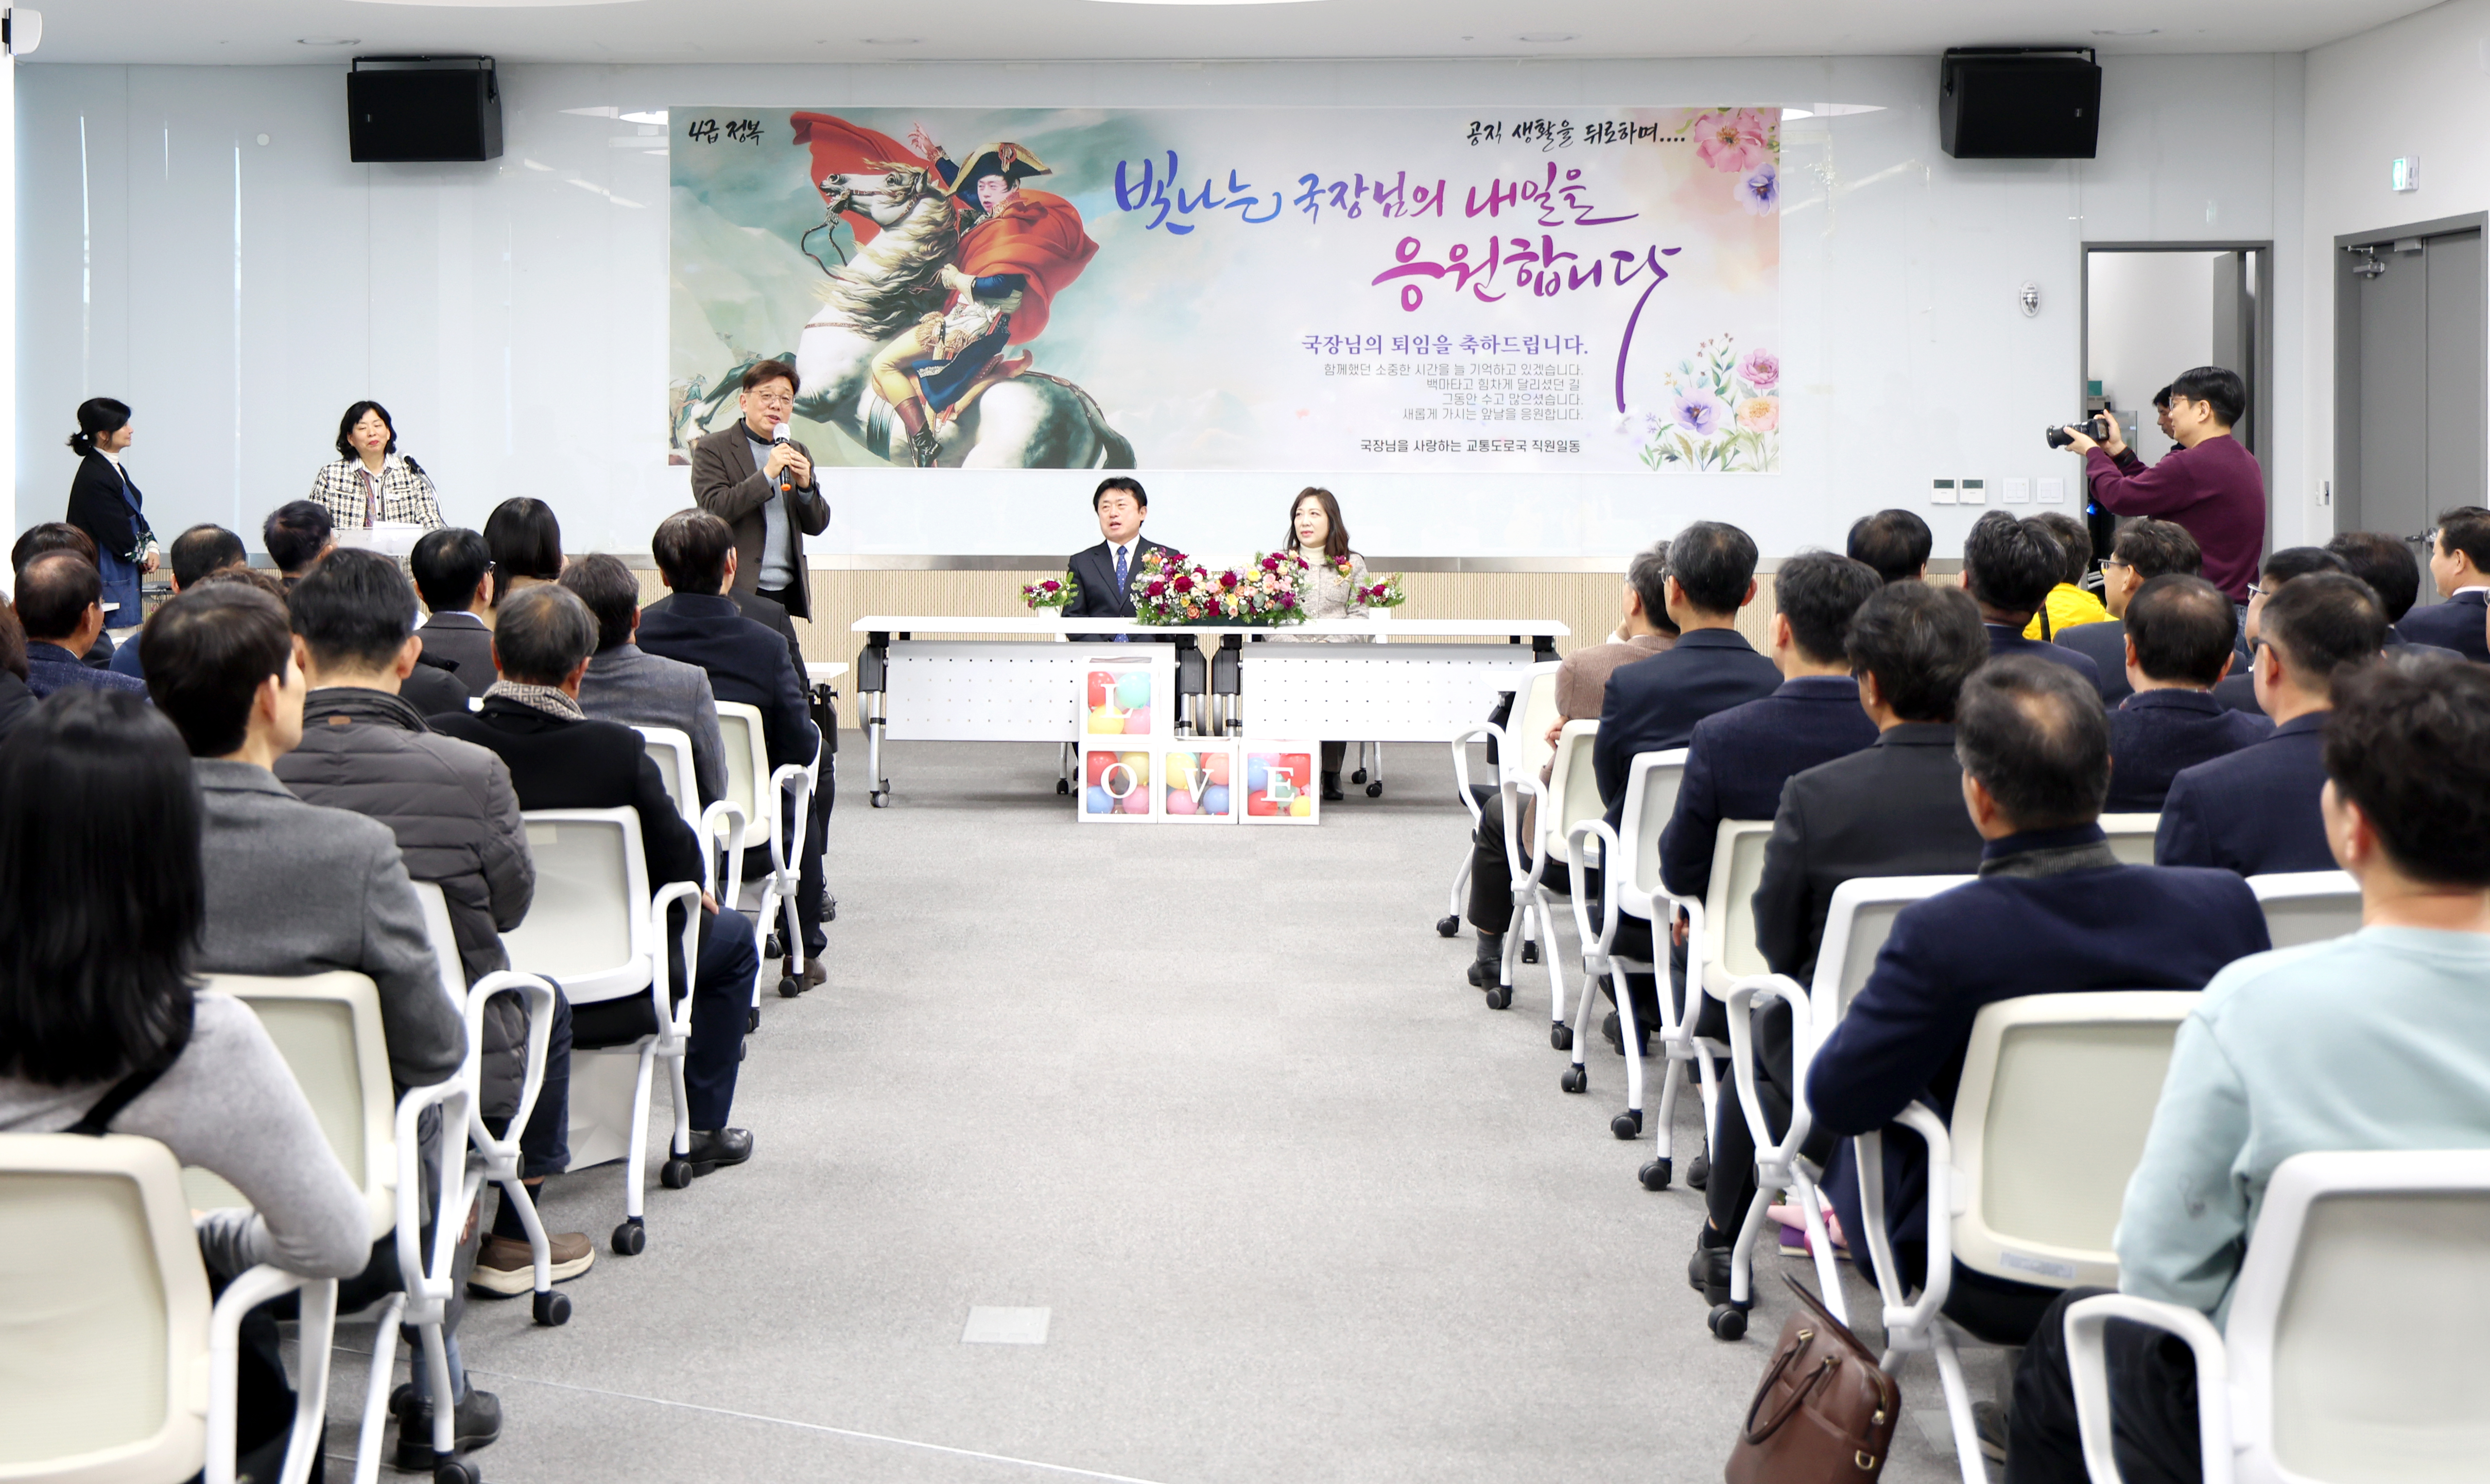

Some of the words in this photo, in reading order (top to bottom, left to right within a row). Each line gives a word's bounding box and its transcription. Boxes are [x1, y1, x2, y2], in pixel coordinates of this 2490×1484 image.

[688, 119, 720, 144] 4급
[1466, 121, 1502, 146] 공직
[1511, 118, 1574, 152] 생활을
[1114, 150, 1282, 235] 빛나는
[1293, 171, 1446, 224] 국장님의
[1465, 161, 1639, 227] 내일을
[1371, 234, 1682, 414] 응원합니다
[1302, 334, 1382, 355] 국장님의
[1391, 334, 1452, 355] 퇴임을
[1459, 334, 1588, 355] 축하드립니다.
[1325, 363, 1370, 376] 함께했던
[1376, 363, 1411, 376] 소중한
[1415, 363, 1449, 376] 시간을
[1454, 363, 1465, 376] 늘
[1470, 363, 1516, 376] 기억하고
[1521, 363, 1583, 376] 있겠습니다.
[1427, 378, 1473, 390] 백마타고
[1478, 378, 1512, 391] 힘차게
[1518, 379, 1564, 391] 달리셨던
[1569, 379, 1579, 391] 길
[1443, 393, 1477, 406] 그동안
[1482, 393, 1504, 405] 수고
[1509, 393, 1583, 406] 많으셨습니다.
[1403, 408, 1437, 420] 새롭게
[1443, 408, 1476, 420] 가시는
[1481, 408, 1516, 420] 앞날을
[1521, 408, 1583, 421] 응원합니다.
[1361, 440, 1408, 452] 국장님을
[1414, 439, 1461, 452] 사랑하는
[1467, 440, 1527, 452] 교통도로국
[1532, 440, 1580, 453] 직원일동
